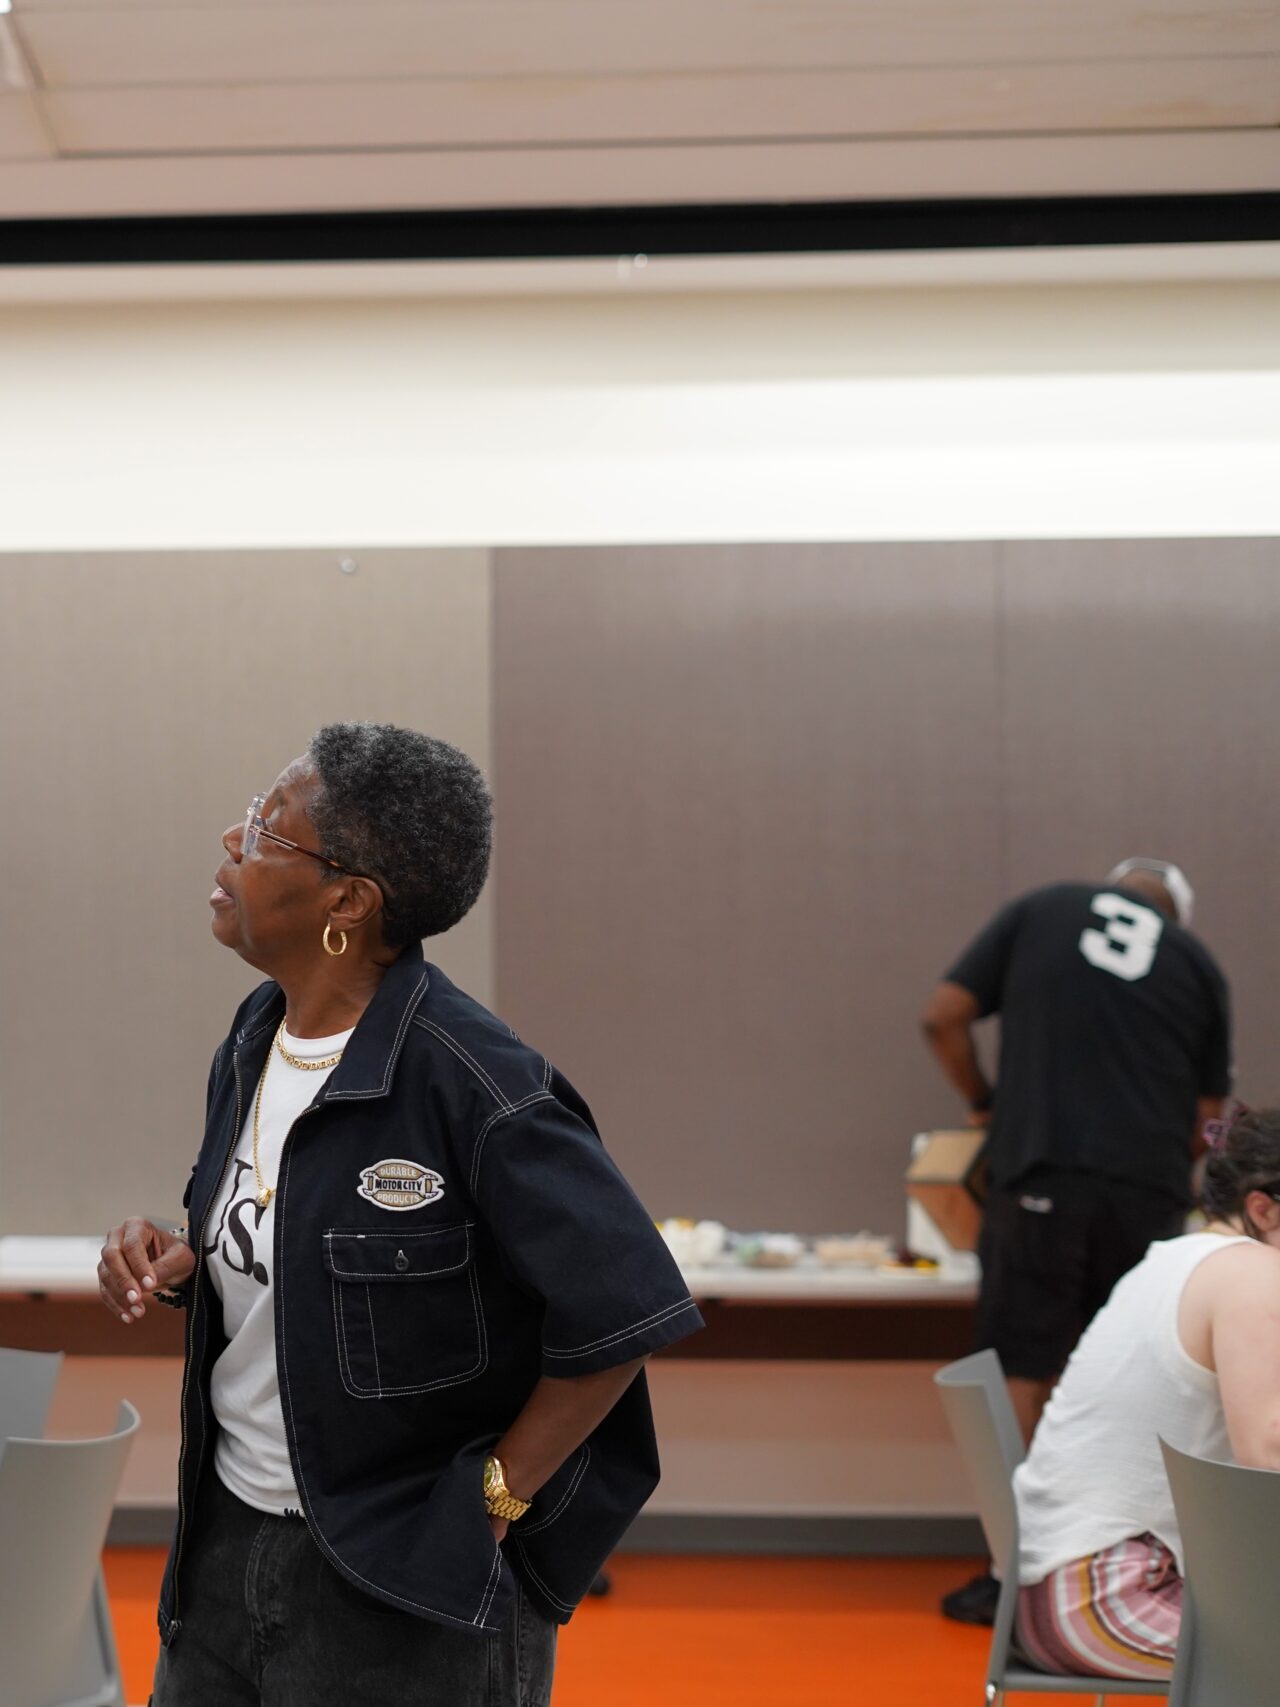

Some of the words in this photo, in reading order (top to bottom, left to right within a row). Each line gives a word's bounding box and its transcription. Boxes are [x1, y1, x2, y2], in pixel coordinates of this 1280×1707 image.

[1078, 892, 1164, 982] 3
[380, 1166, 417, 1177] DURABLE
[377, 1193, 420, 1203] PRODUCTS
